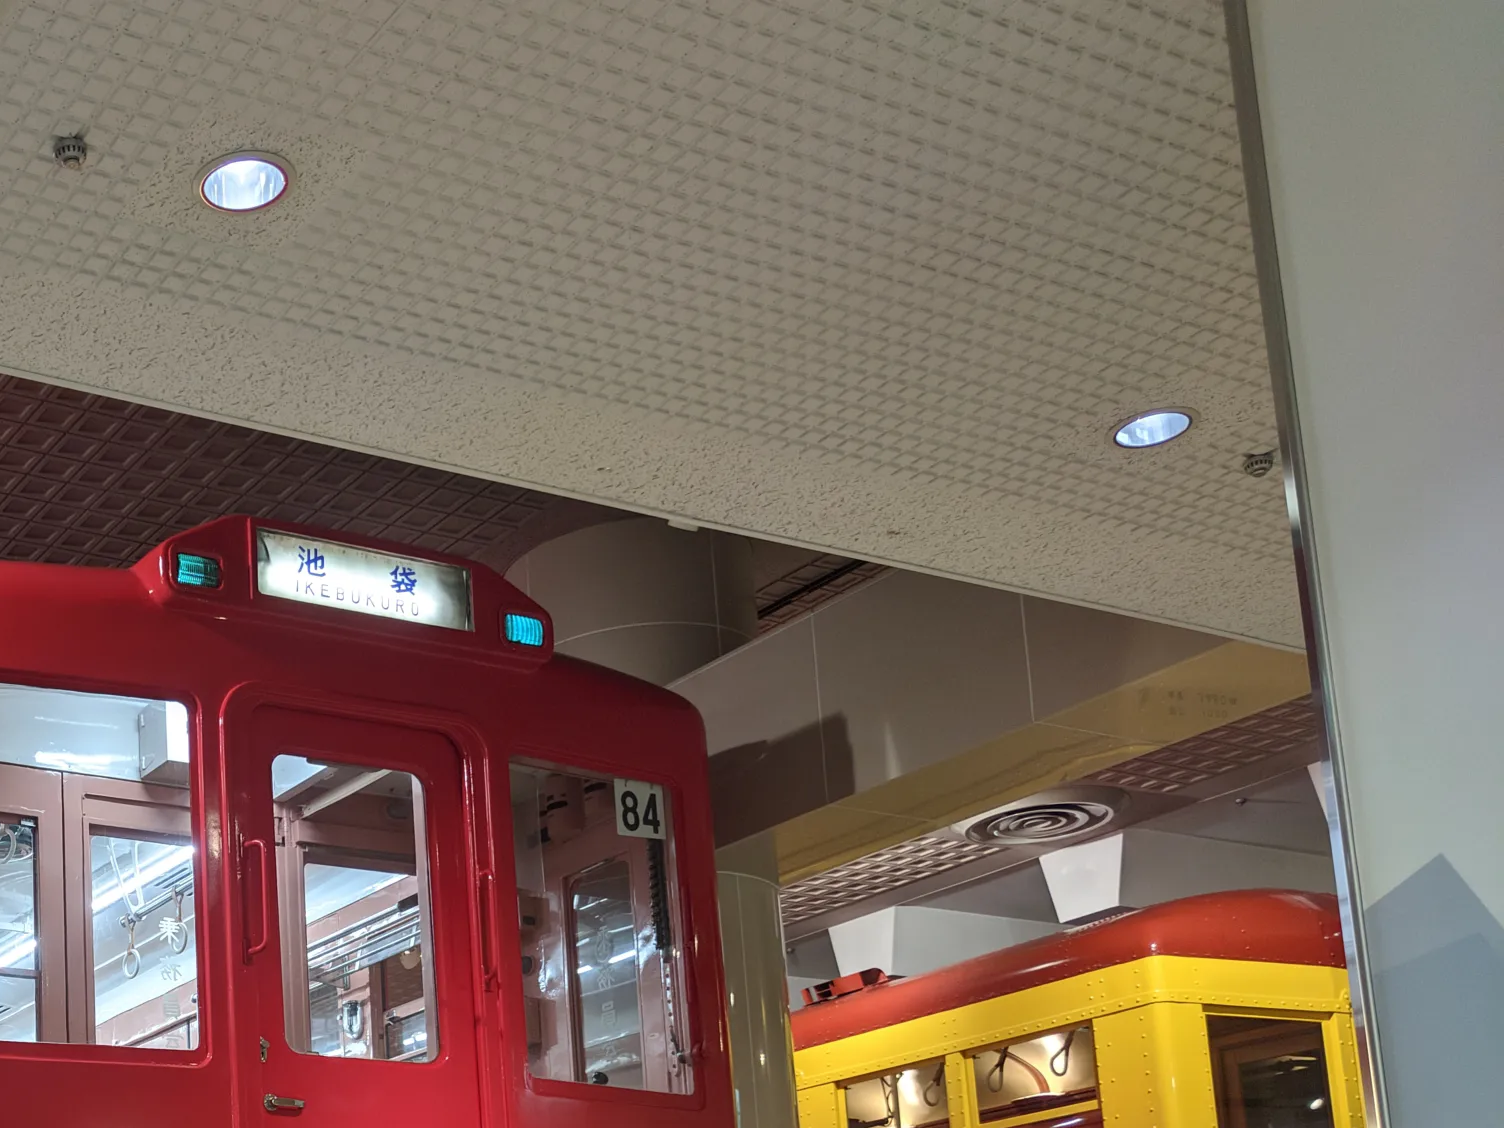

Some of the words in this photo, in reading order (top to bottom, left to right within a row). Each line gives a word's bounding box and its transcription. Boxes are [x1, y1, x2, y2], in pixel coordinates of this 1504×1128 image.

[297, 545, 418, 596] 池袋
[295, 581, 421, 616] IKEBUKURO
[620, 792, 661, 834] 84
